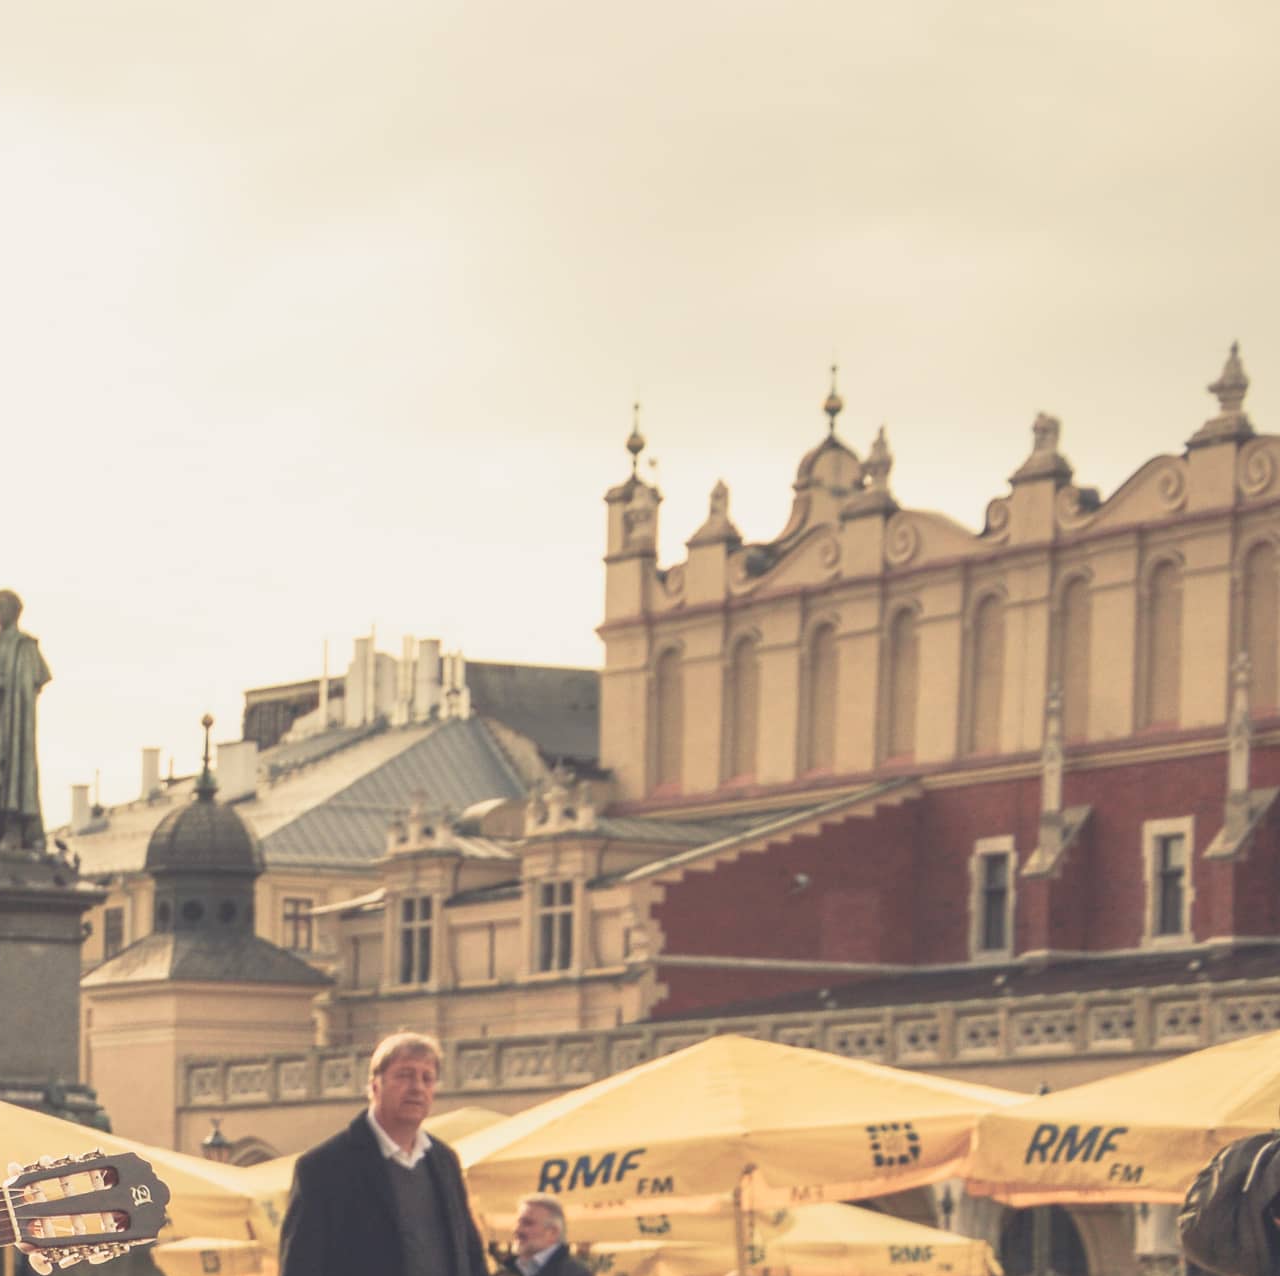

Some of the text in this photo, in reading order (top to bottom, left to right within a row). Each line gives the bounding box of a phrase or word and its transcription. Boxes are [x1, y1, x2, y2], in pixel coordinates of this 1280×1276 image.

[538, 1148, 673, 1195] RMF FM
[1025, 1123, 1144, 1183] RMF FM
